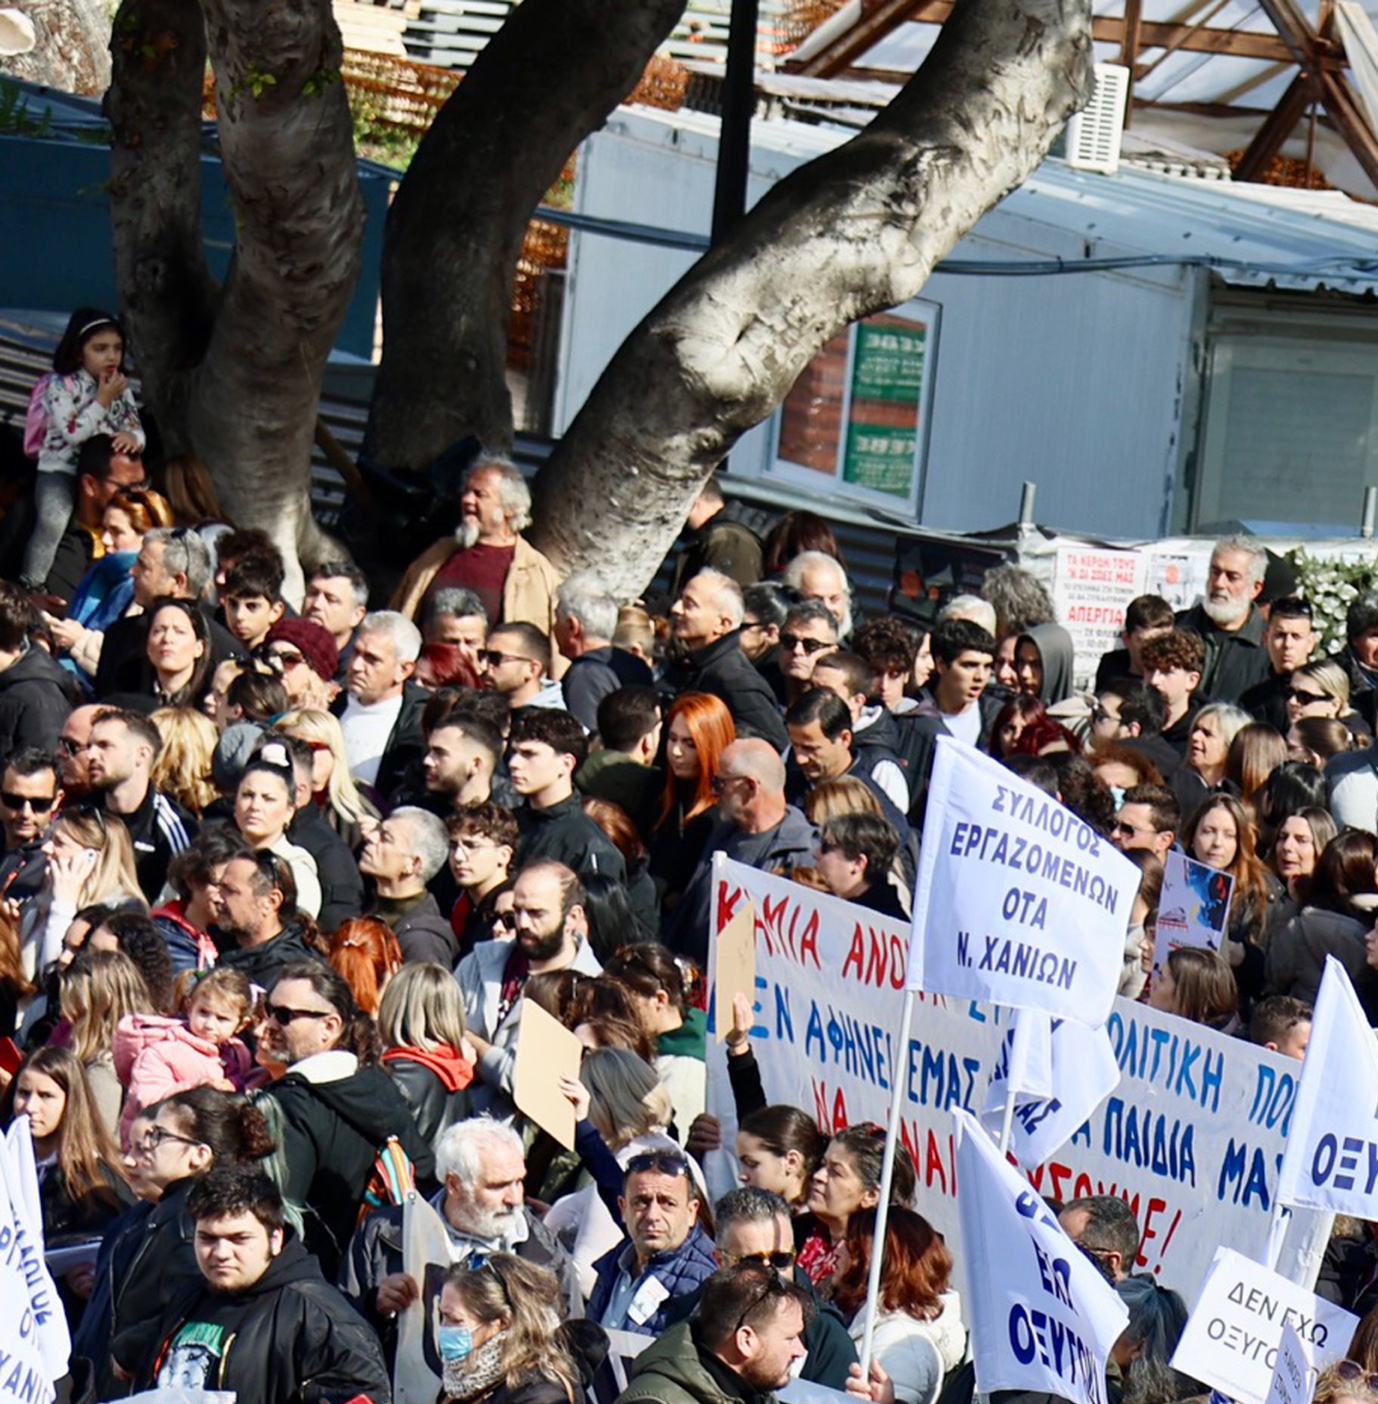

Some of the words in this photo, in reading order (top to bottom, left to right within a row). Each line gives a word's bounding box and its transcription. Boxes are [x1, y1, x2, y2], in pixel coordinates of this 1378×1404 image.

[1068, 605, 1123, 625] ΑΠΕΡΓΙΑ
[991, 784, 1101, 859] ΣΥΛΛΟΓΟΣ
[949, 821, 1119, 915] ΕΡΓΑΖΟΜΕΝΩΝ
[1002, 886, 1049, 931] ΟΤΑ
[957, 931, 972, 968] Ν.
[978, 935, 1077, 991] ΧΑΝΙΩΝ
[1105, 1011, 1224, 1114] ΟΛΙΤΙΚΗ
[1102, 1096, 1197, 1189] ΠΑΙΔΙΑ
[1227, 1281, 1279, 1321] ΔΕΝ
